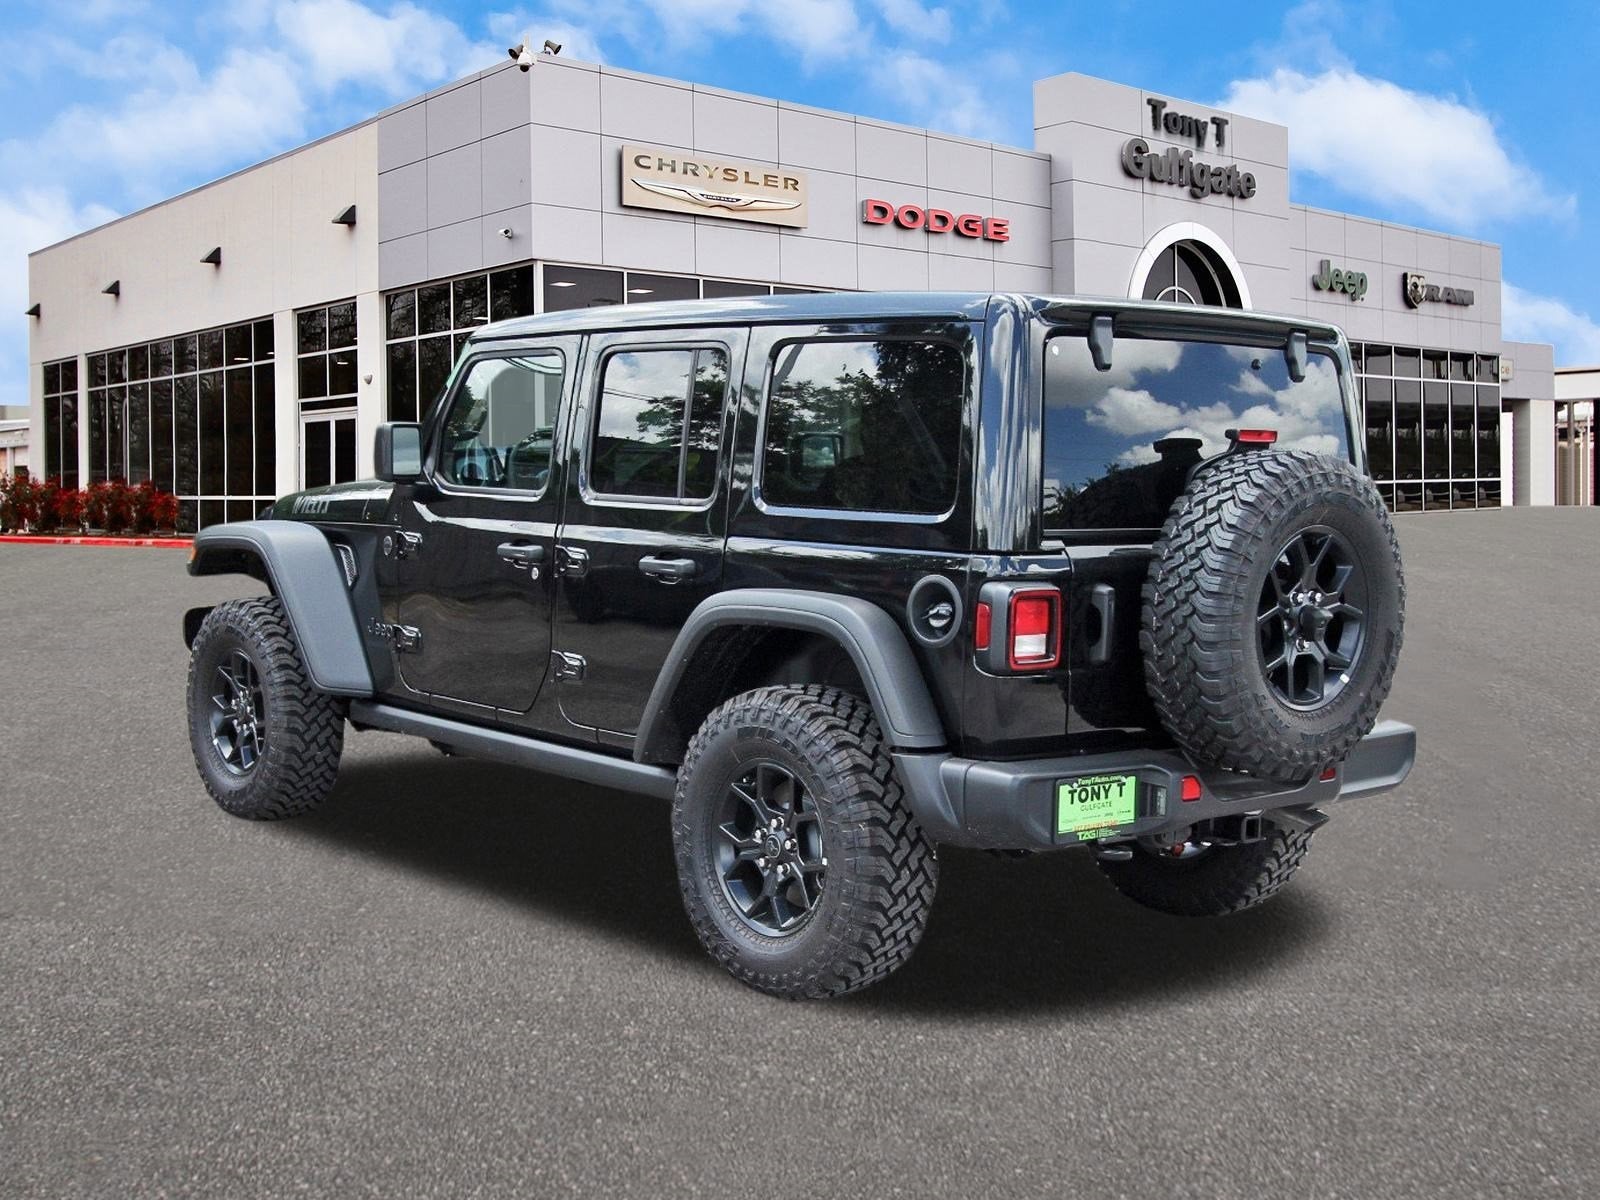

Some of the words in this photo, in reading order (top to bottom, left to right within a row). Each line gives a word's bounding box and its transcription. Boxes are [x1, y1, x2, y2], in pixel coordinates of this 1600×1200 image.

[1146, 98, 1208, 148] Tony
[1210, 116, 1229, 148] T
[633, 153, 800, 192] CHRYSLER
[1121, 138, 1256, 199] Gulfgate
[862, 198, 1010, 242] DODGE
[1312, 259, 1367, 301] Jeep
[1424, 284, 1475, 306] RAM
[1068, 784, 1112, 805] TONY
[1117, 782, 1126, 797] T
